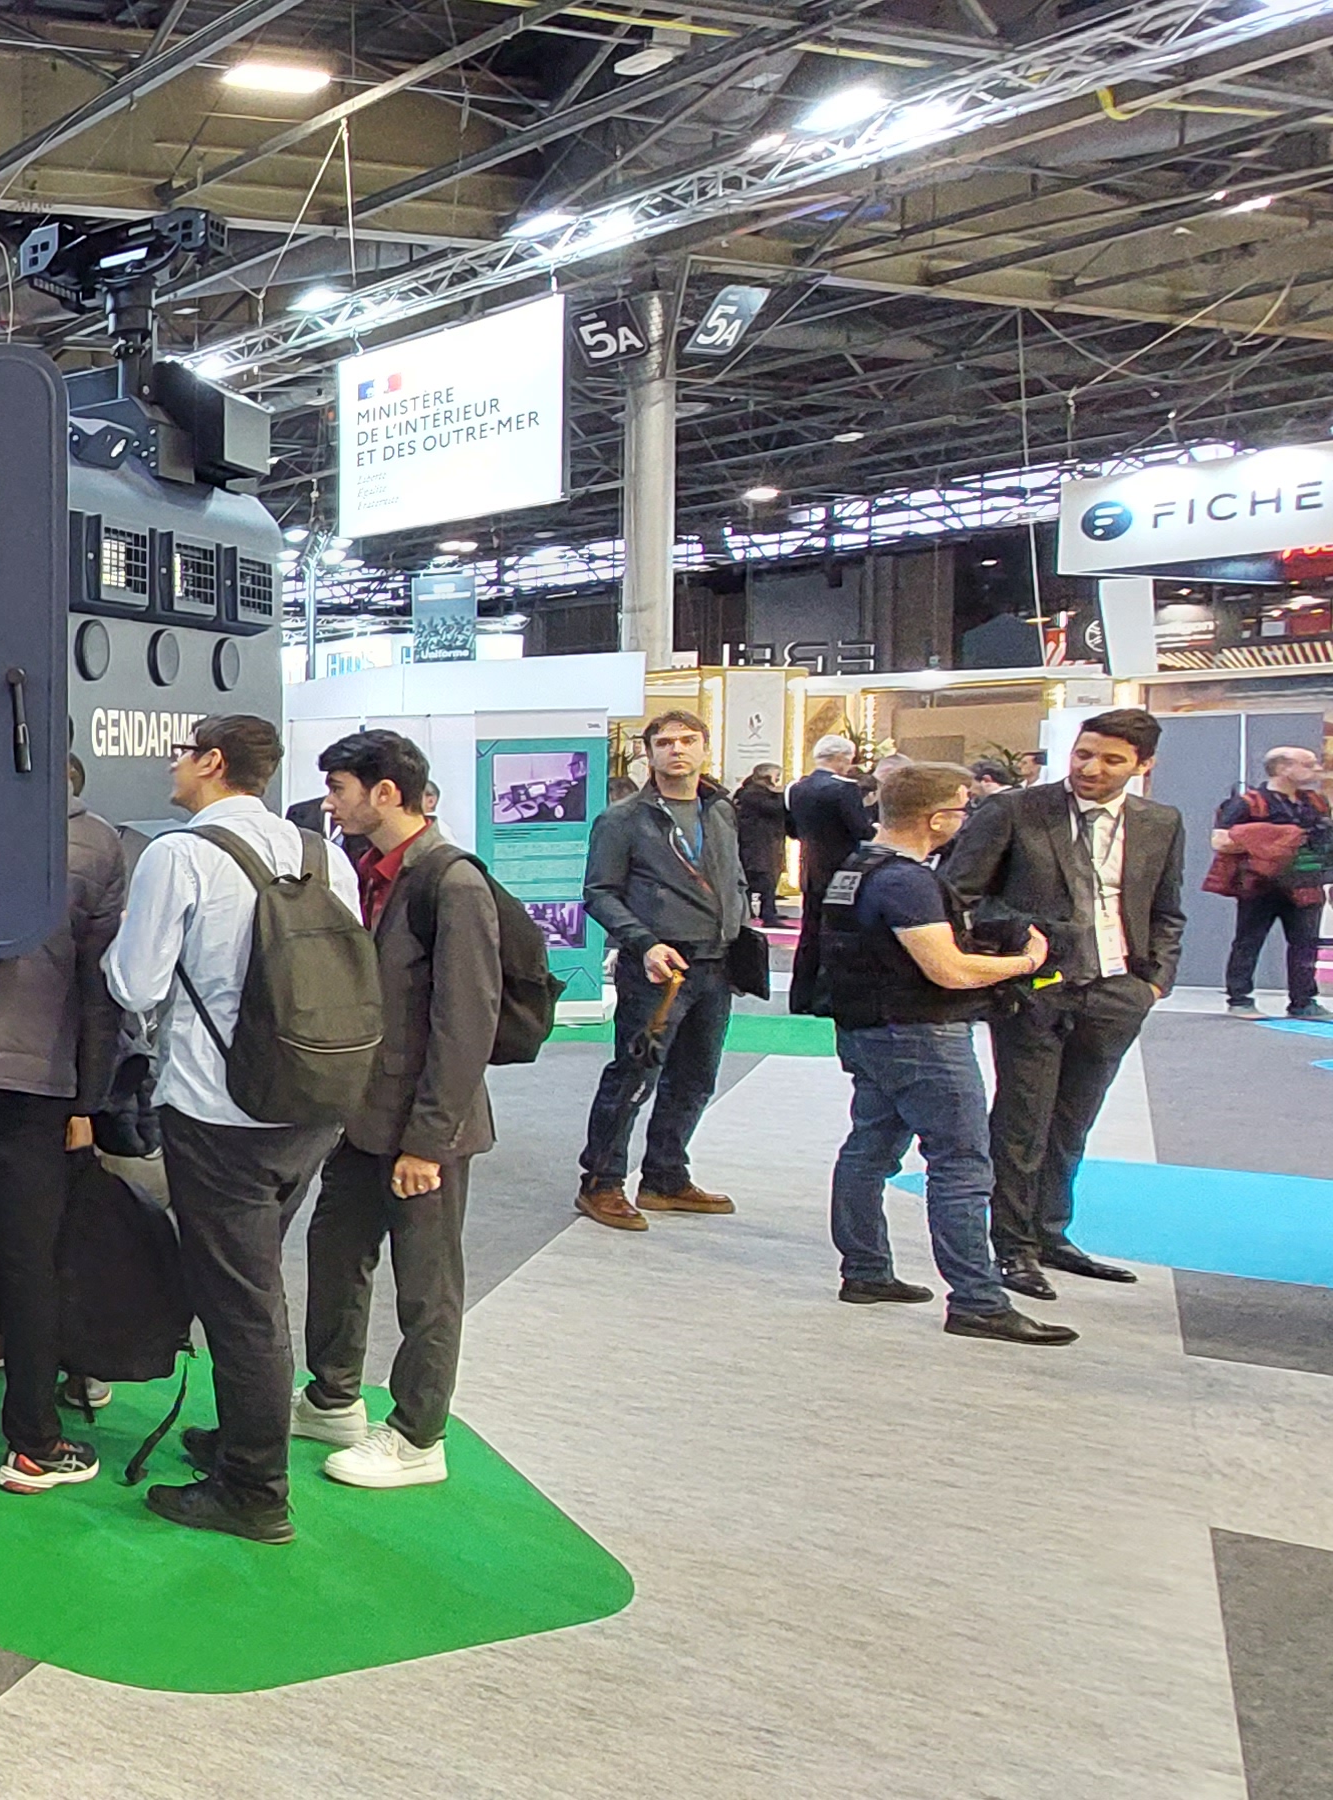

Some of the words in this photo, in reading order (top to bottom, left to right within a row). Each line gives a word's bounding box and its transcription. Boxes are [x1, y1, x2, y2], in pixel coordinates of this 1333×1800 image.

[579, 320, 644, 359] 5A
[696, 304, 743, 347] 5A
[357, 387, 454, 426] MINISTÈRE
[357, 427, 379, 447] DE
[385, 398, 501, 440] L'INTÉRIEUR
[357, 449, 376, 467] ET
[383, 440, 416, 462] DES
[423, 411, 540, 452] OUTRE-MER
[1152, 480, 1323, 529] FICHE
[91, 707, 208, 758] GENDARM
